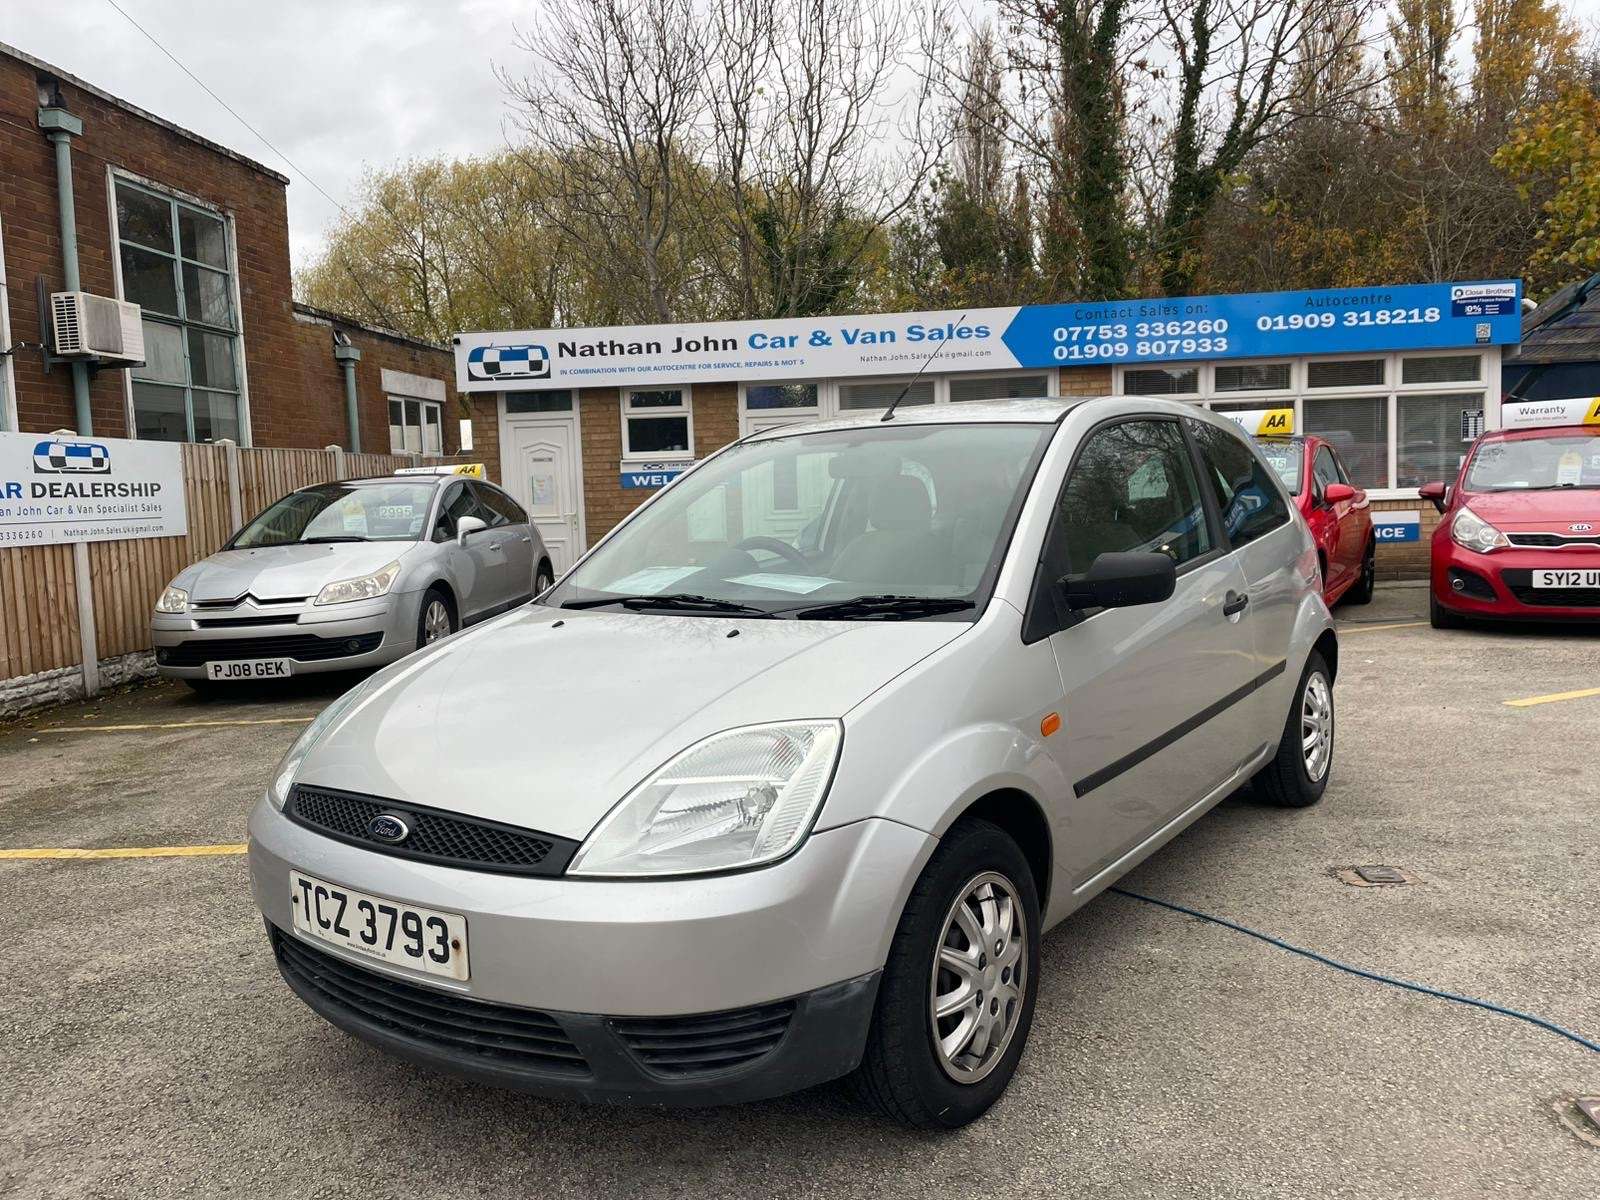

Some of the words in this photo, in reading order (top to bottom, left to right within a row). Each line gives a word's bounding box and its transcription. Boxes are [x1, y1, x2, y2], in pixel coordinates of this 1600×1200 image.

[1305, 292, 1393, 307] Autocentre
[1075, 307, 1133, 320] Contact
[1139, 303, 1178, 317] Sales
[1185, 303, 1208, 314] on:
[1257, 312, 1336, 331] 01909
[1343, 307, 1440, 326] 318218
[1053, 324, 1128, 342] 07753
[1135, 319, 1229, 337] 336260
[558, 339, 661, 358] Nathan
[671, 336, 738, 353] John
[748, 332, 798, 350] Car
[808, 329, 832, 347] &
[841, 327, 896, 345] Van
[906, 322, 991, 342] Sales
[1053, 342, 1129, 360] 01909
[1136, 337, 1228, 355] 807933
[653, 363, 696, 371] AUTOCENTRE
[1520, 405, 1566, 415] Warranty
[1266, 415, 1286, 428] AA
[31, 482, 161, 498] DEALERSHIP
[17, 506, 42, 515] John
[47, 504, 63, 515] Car
[68, 504, 74, 514] &
[77, 504, 93, 514] Van
[97, 504, 138, 513] Specialist
[141, 503, 162, 512] Sales
[1543, 572, 1581, 586] SY12
[1586, 572, 1600, 586] U
[213, 663, 251, 678] PJ08
[255, 661, 285, 676] GEK
[374, 819, 398, 837] Ford
[298, 878, 350, 938] TCZ
[357, 899, 450, 964] 3793
